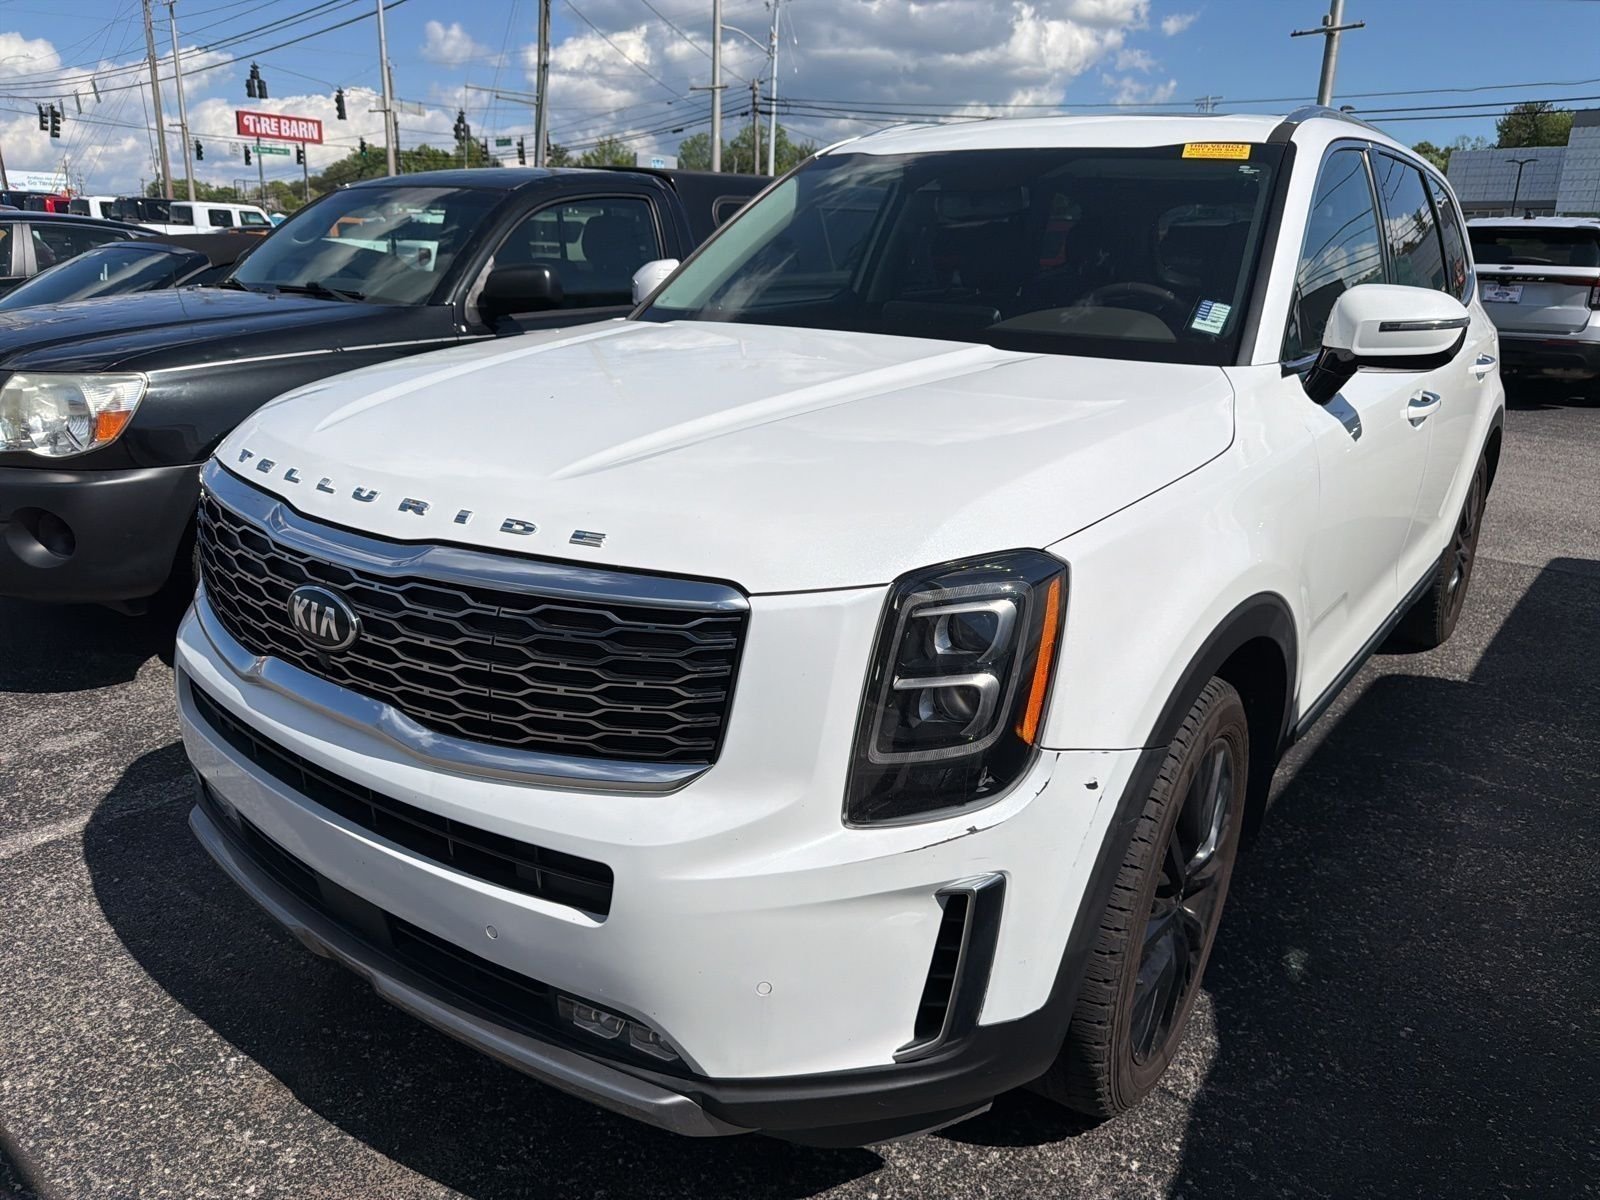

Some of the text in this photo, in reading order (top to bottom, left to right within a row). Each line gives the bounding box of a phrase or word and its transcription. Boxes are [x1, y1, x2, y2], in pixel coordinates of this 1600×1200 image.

[243, 115, 319, 140] TIRE BARN
[238, 448, 608, 548] TELLURIDE
[293, 594, 340, 641] KIA
